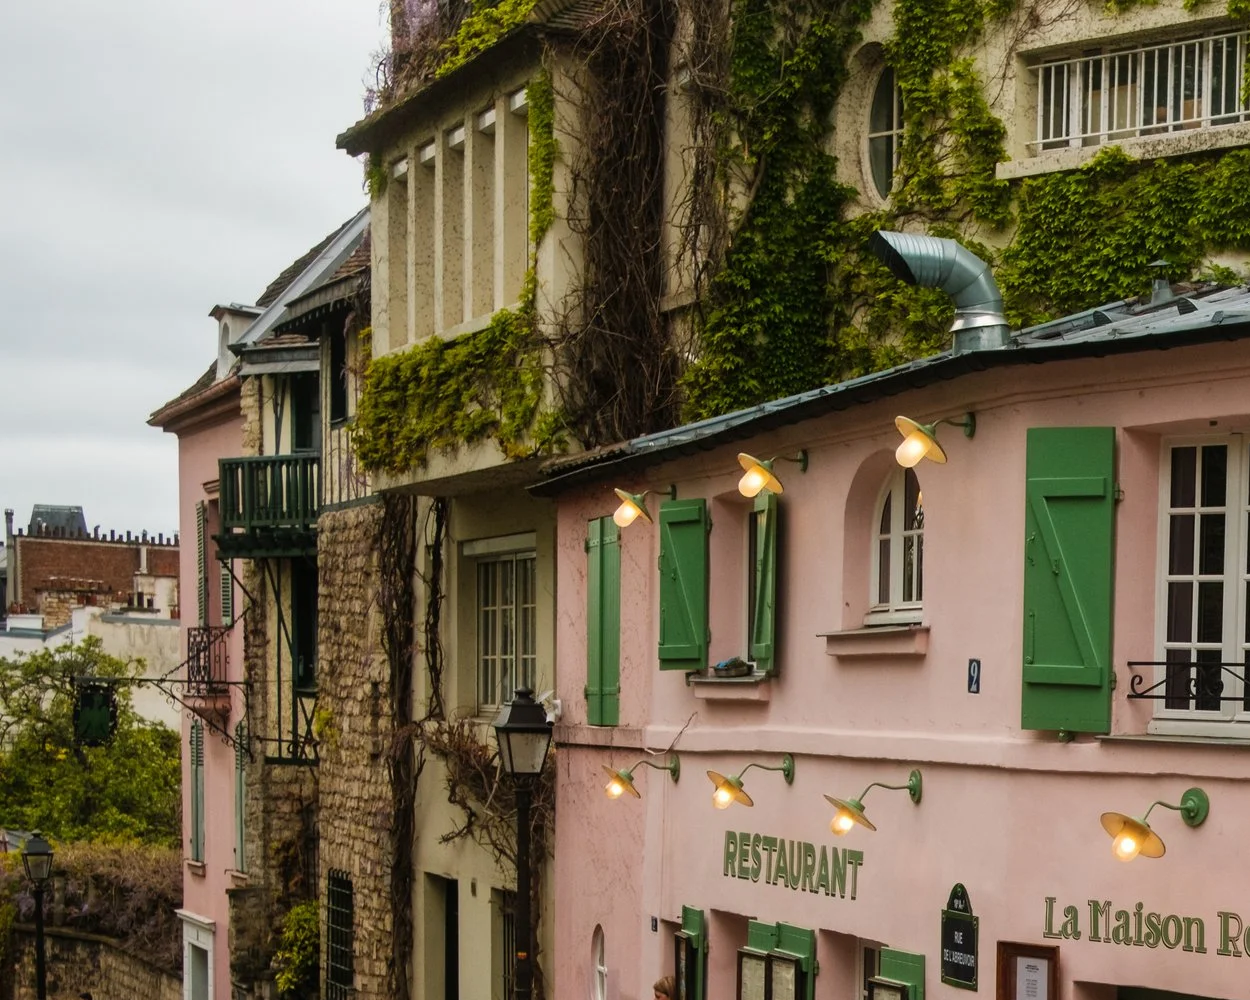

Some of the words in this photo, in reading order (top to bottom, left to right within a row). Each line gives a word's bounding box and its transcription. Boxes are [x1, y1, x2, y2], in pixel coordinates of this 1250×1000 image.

[723, 830, 864, 900] RESTAURANT
[954, 930, 963, 944] RUE
[1043, 896, 1082, 940] La
[1087, 899, 1208, 954] Maison
